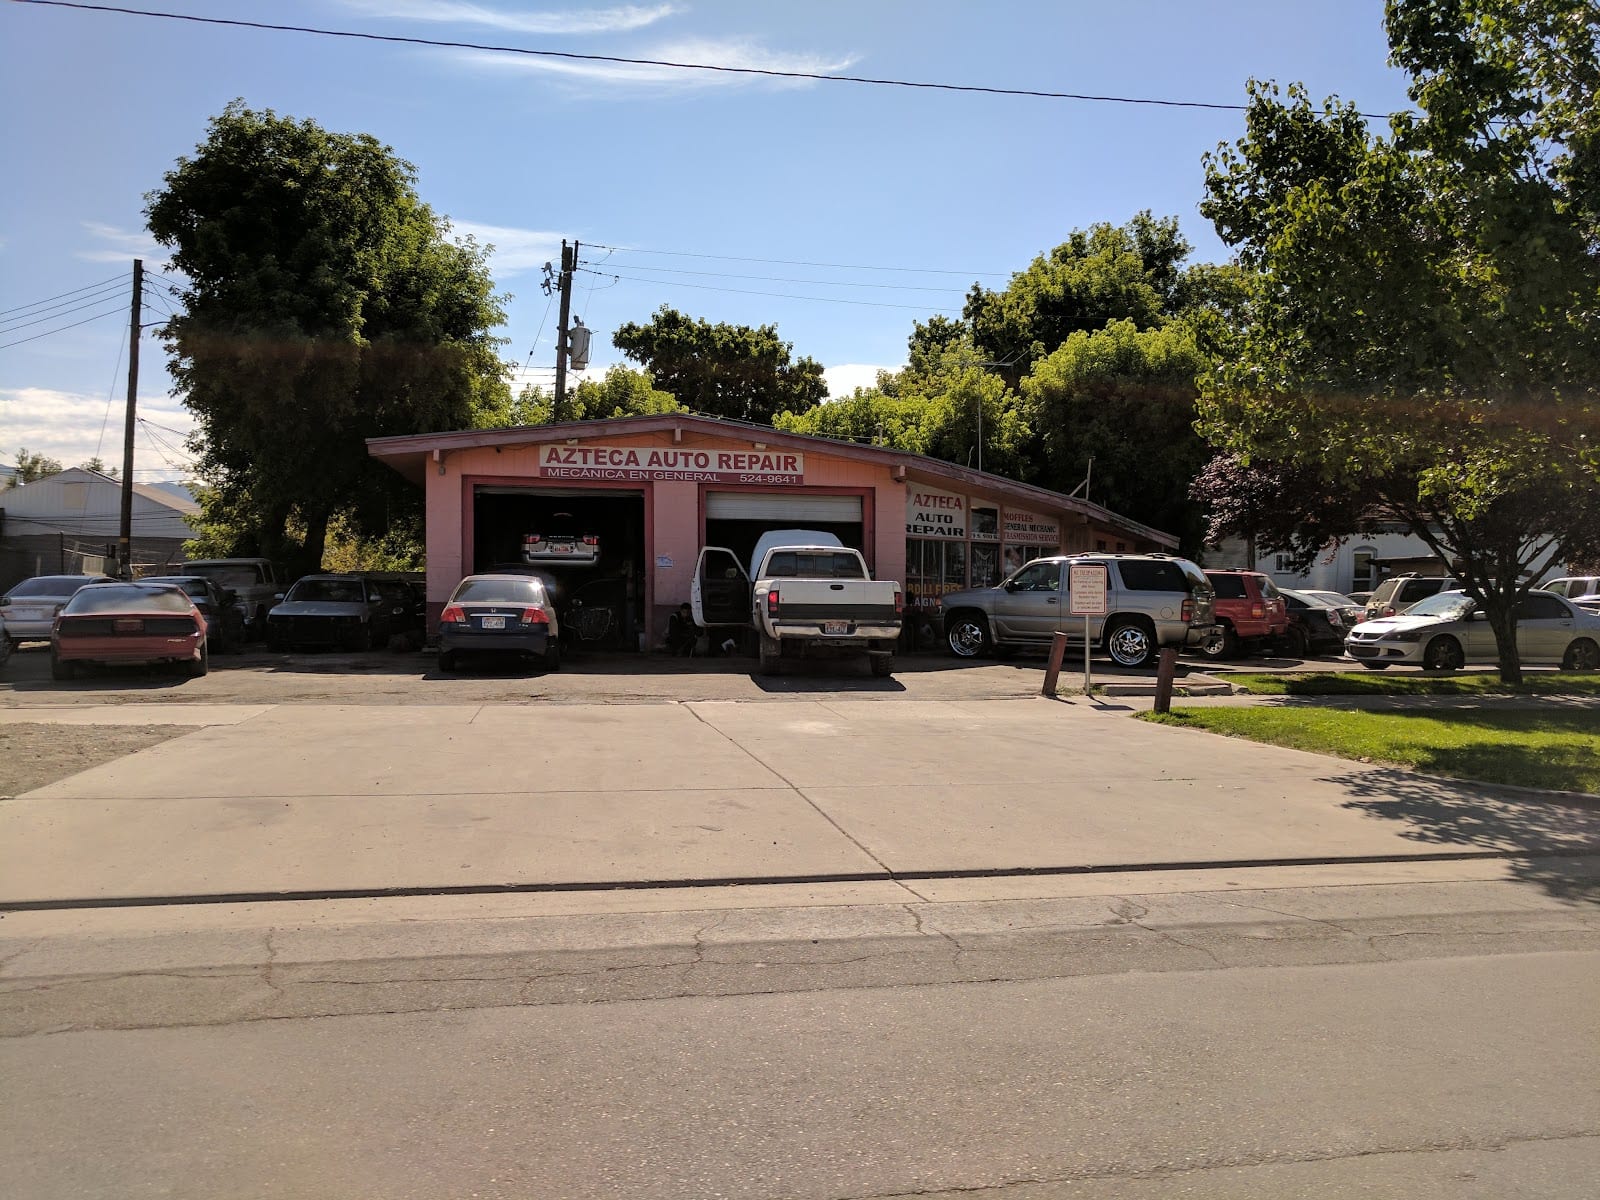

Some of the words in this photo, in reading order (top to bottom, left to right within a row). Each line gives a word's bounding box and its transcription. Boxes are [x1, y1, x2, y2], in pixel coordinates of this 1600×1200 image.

[545, 447, 640, 467] AZTECA
[647, 452, 710, 469] AUTO
[718, 453, 798, 472] REPAIR
[630, 470, 649, 480] EN
[653, 471, 721, 482] GENERAL
[739, 474, 797, 484] 524-9641
[913, 493, 963, 511] AZTECA
[915, 513, 953, 524] AUTO
